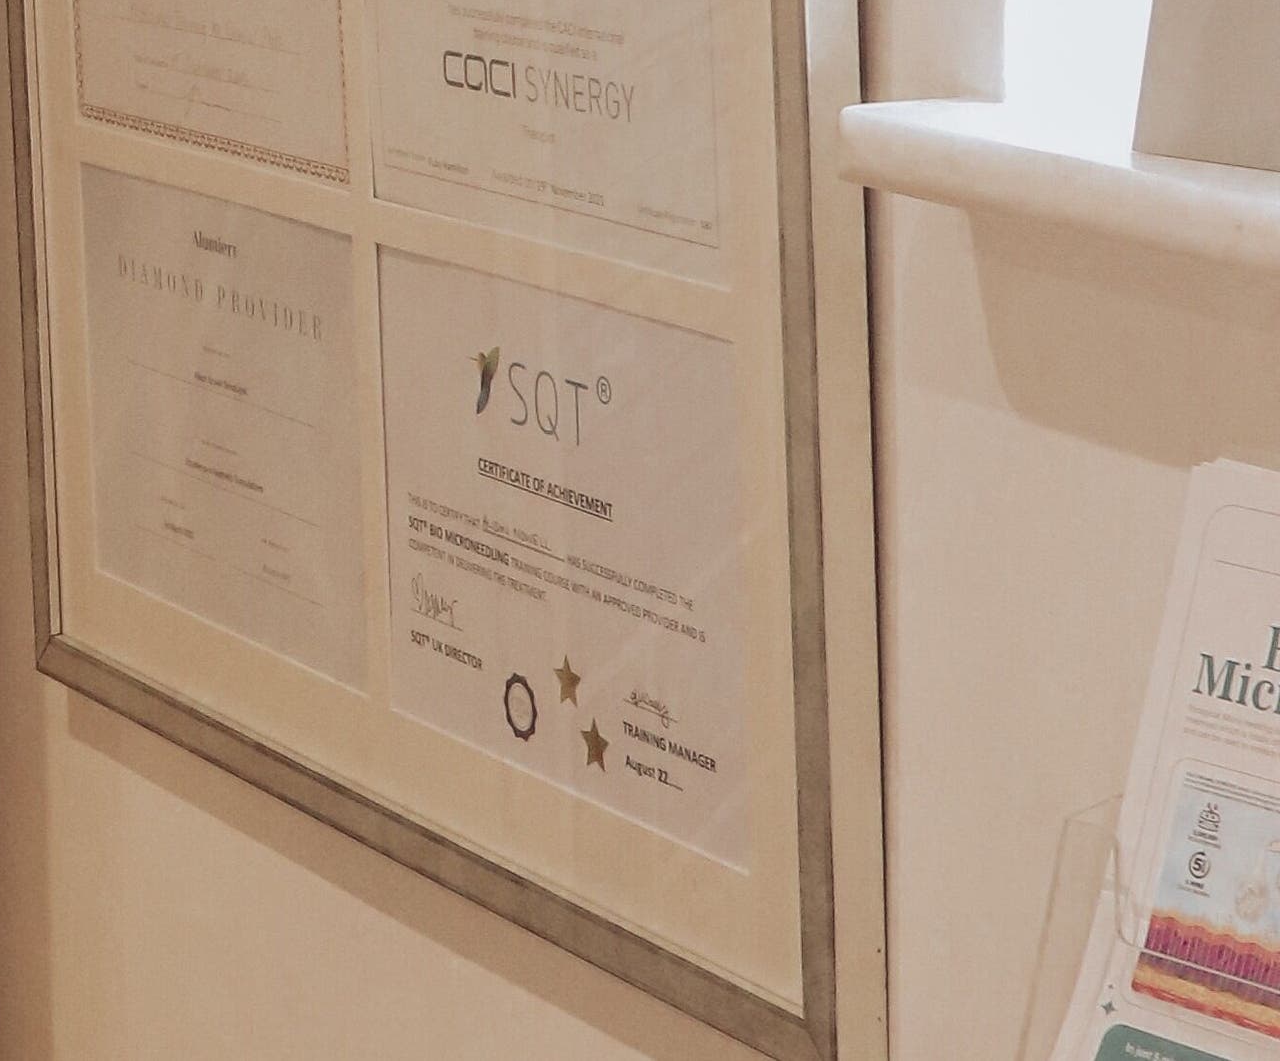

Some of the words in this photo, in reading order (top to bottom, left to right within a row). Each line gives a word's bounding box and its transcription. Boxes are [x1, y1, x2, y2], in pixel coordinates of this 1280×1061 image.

[524, 64, 635, 124] SYNERGY
[117, 253, 204, 302] DIAMOND
[216, 284, 323, 342] PROVIDER
[478, 457, 531, 489] CERTIFICATE
[532, 476, 545, 492] OF
[546, 483, 614, 519] ACHIEVEMENT
[429, 524, 443, 540] BIO
[444, 529, 510, 567] MICRONEEDLING
[680, 623, 698, 640] AND
[431, 637, 444, 653] UK
[444, 643, 483, 670] DIRECTOR
[622, 720, 667, 753] TRAINING
[668, 739, 718, 773] MANAGER
[625, 754, 656, 778] August
